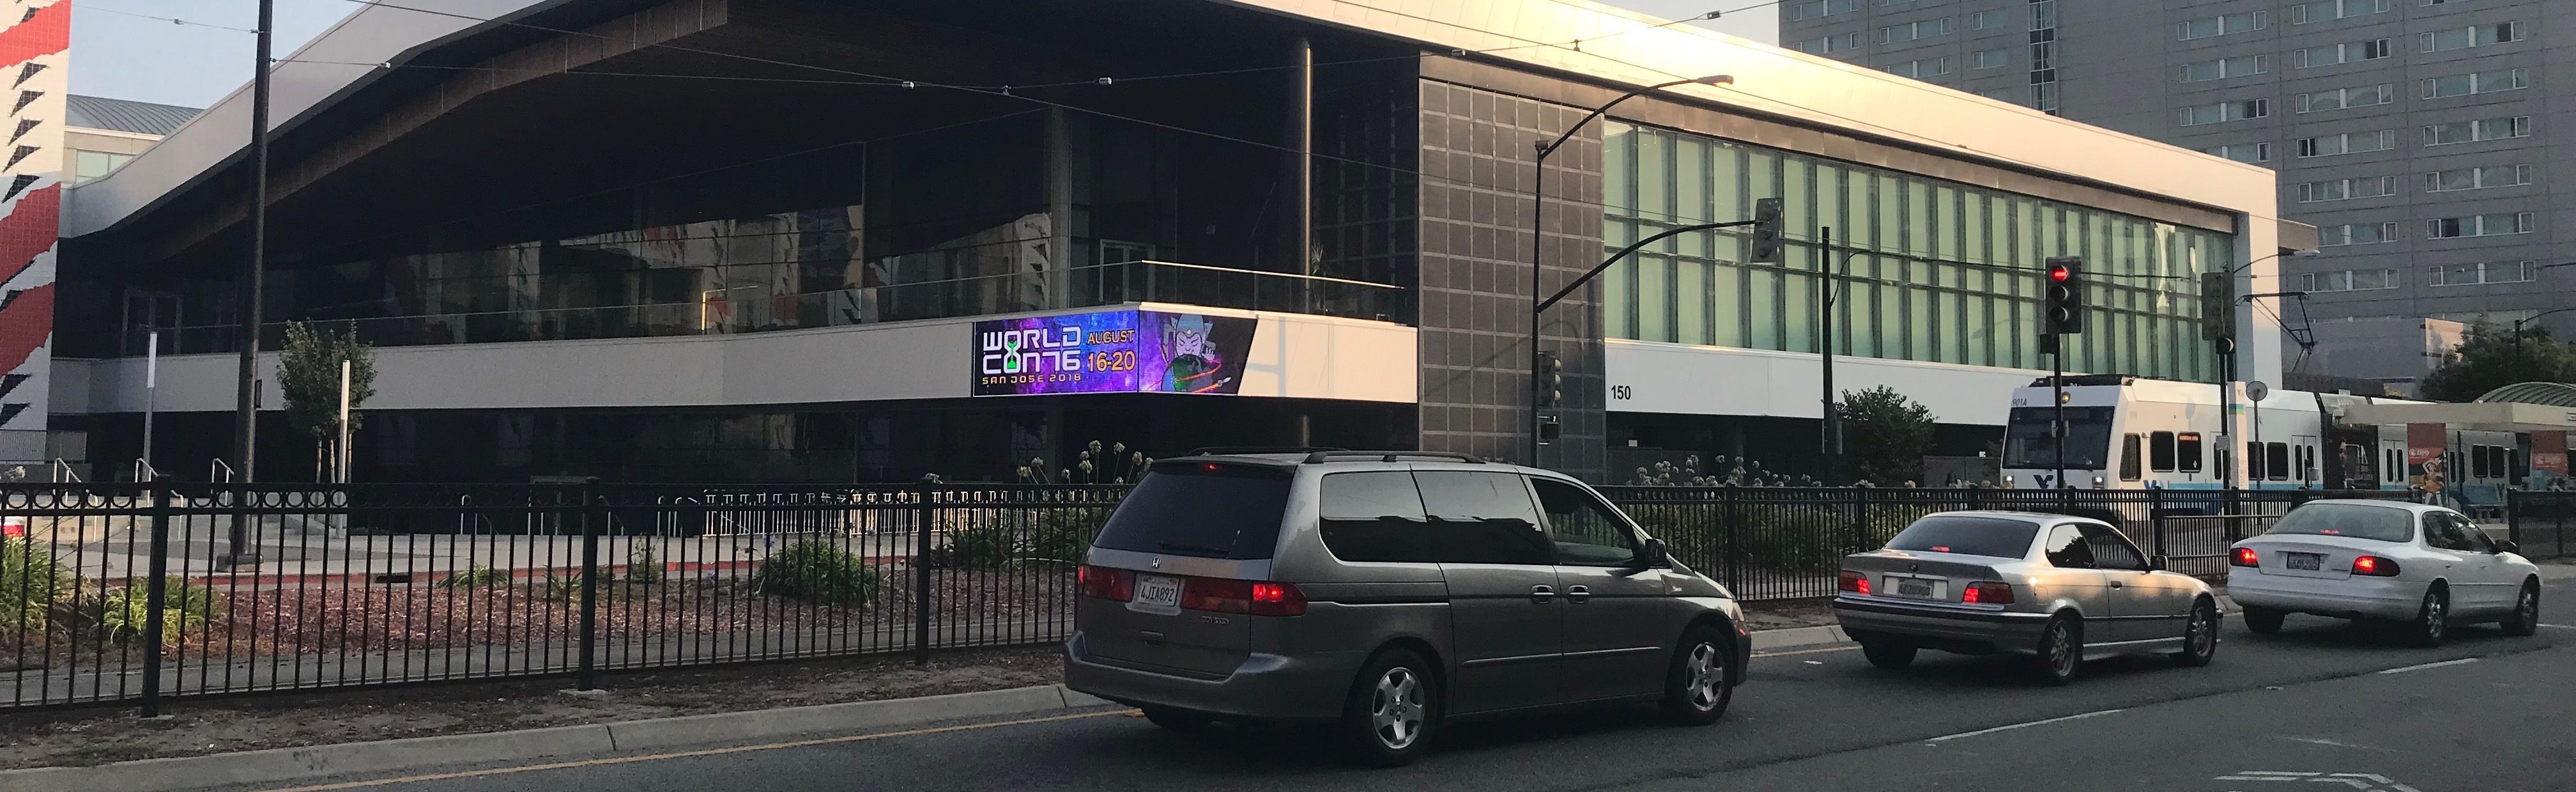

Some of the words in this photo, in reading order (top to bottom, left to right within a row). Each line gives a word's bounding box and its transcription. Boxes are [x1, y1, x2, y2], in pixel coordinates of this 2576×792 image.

[983, 327, 1081, 352] WORLD
[1087, 330, 1135, 345] AUGUST
[1088, 351, 1135, 372] 16-20
[982, 376, 1006, 385] SAN
[1011, 375, 1044, 384] JOSE
[1049, 373, 1081, 382] 2018
[1611, 385, 1631, 400] 150
[1140, 586, 1175, 602] 4JIA892
